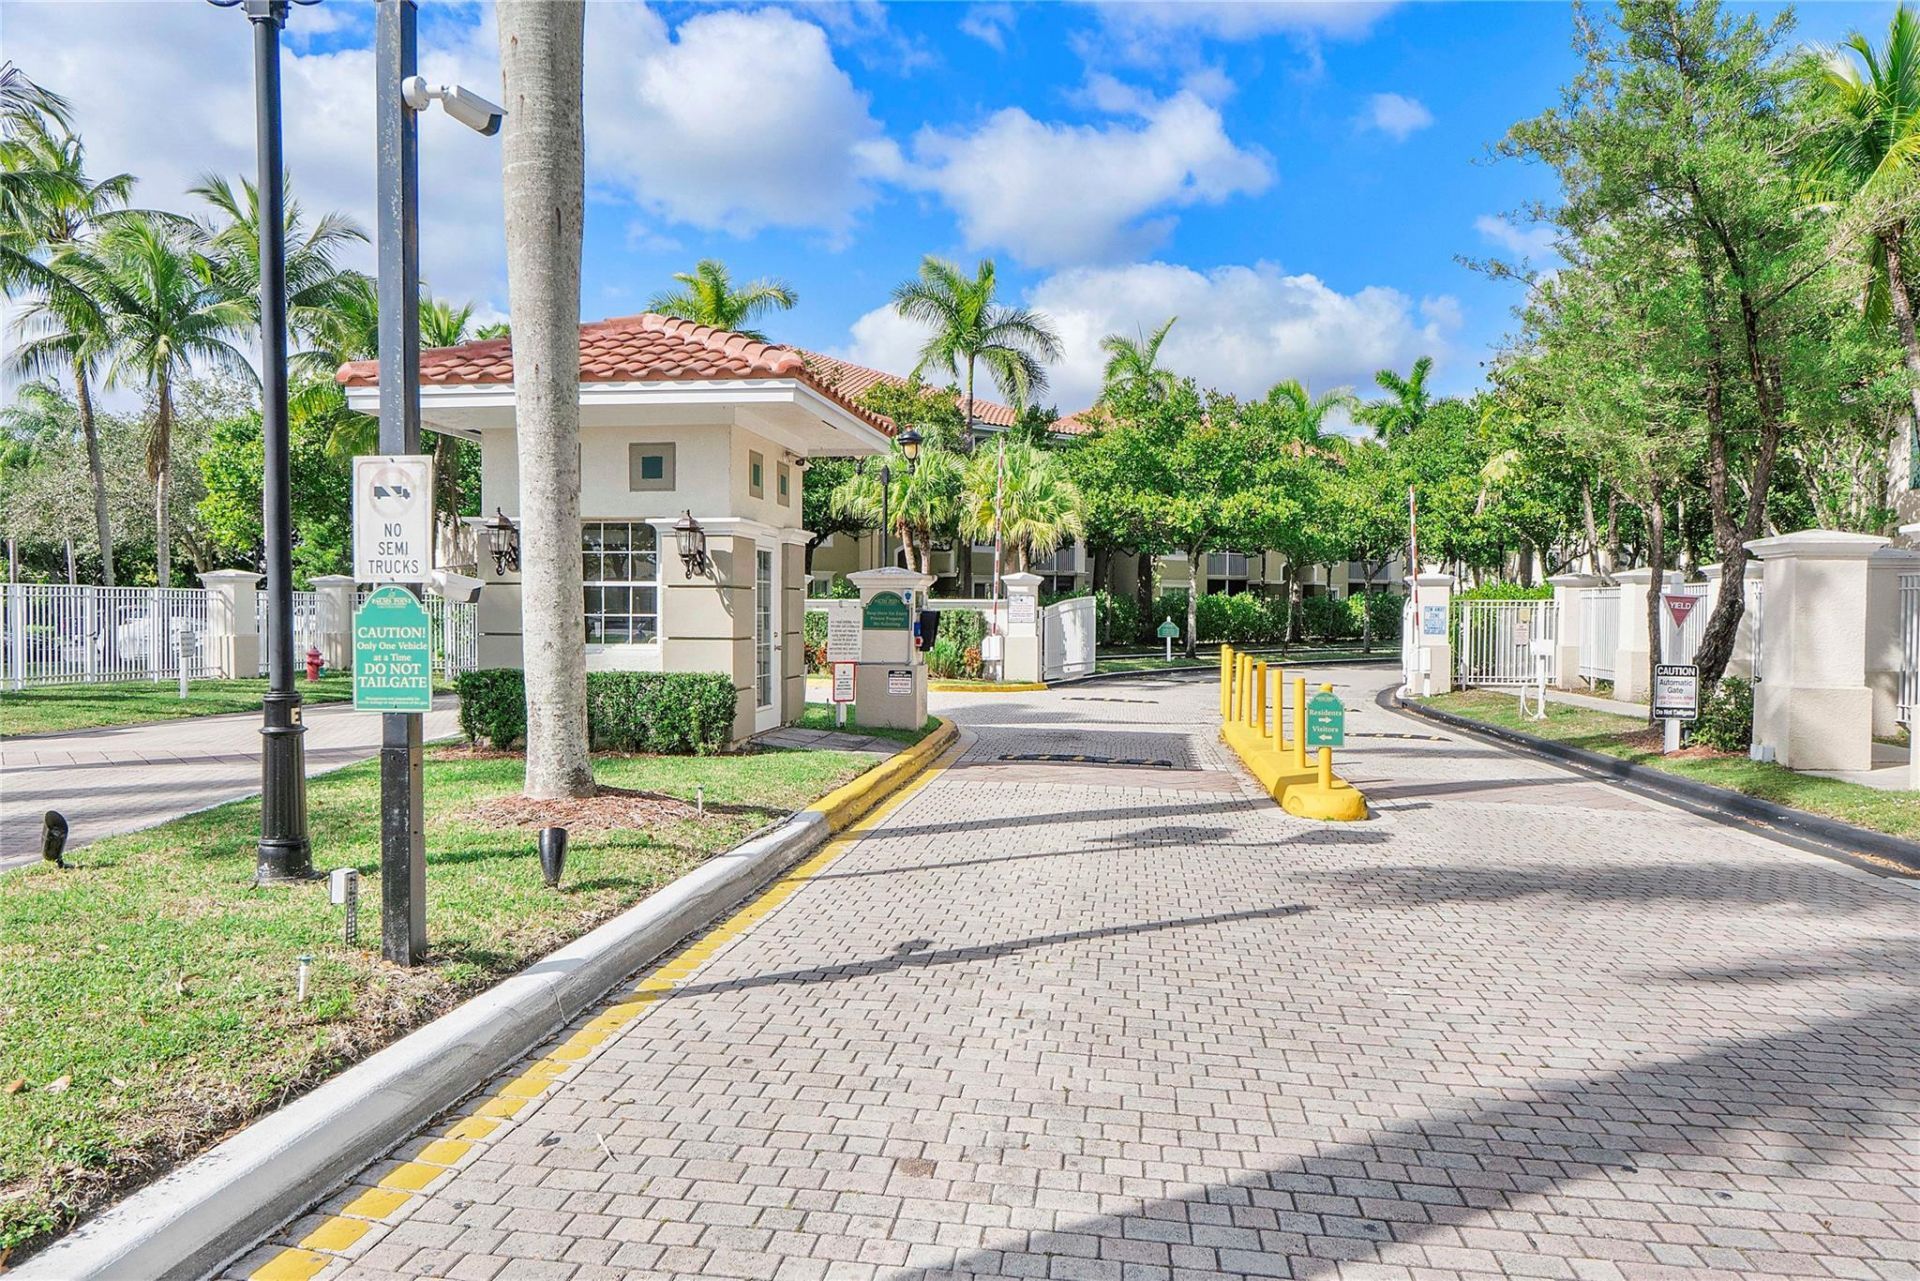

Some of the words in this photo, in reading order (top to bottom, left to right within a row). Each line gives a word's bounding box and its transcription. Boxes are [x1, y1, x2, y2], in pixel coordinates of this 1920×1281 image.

[384, 522, 402, 537] NO
[378, 541, 408, 556] SEMI
[368, 559, 419, 574] TRUCKS
[1670, 601, 1692, 610] YIELD
[357, 626, 426, 639] CAUTION!
[357, 641, 377, 652] Only
[378, 641, 397, 650] One
[398, 641, 428, 650] Vehicle
[390, 653, 412, 662] Time
[364, 662, 386, 675] DO
[389, 662, 421, 675] NOT
[1657, 666, 1696, 676] CAUTION
[357, 676, 428, 689] TAILGATE
